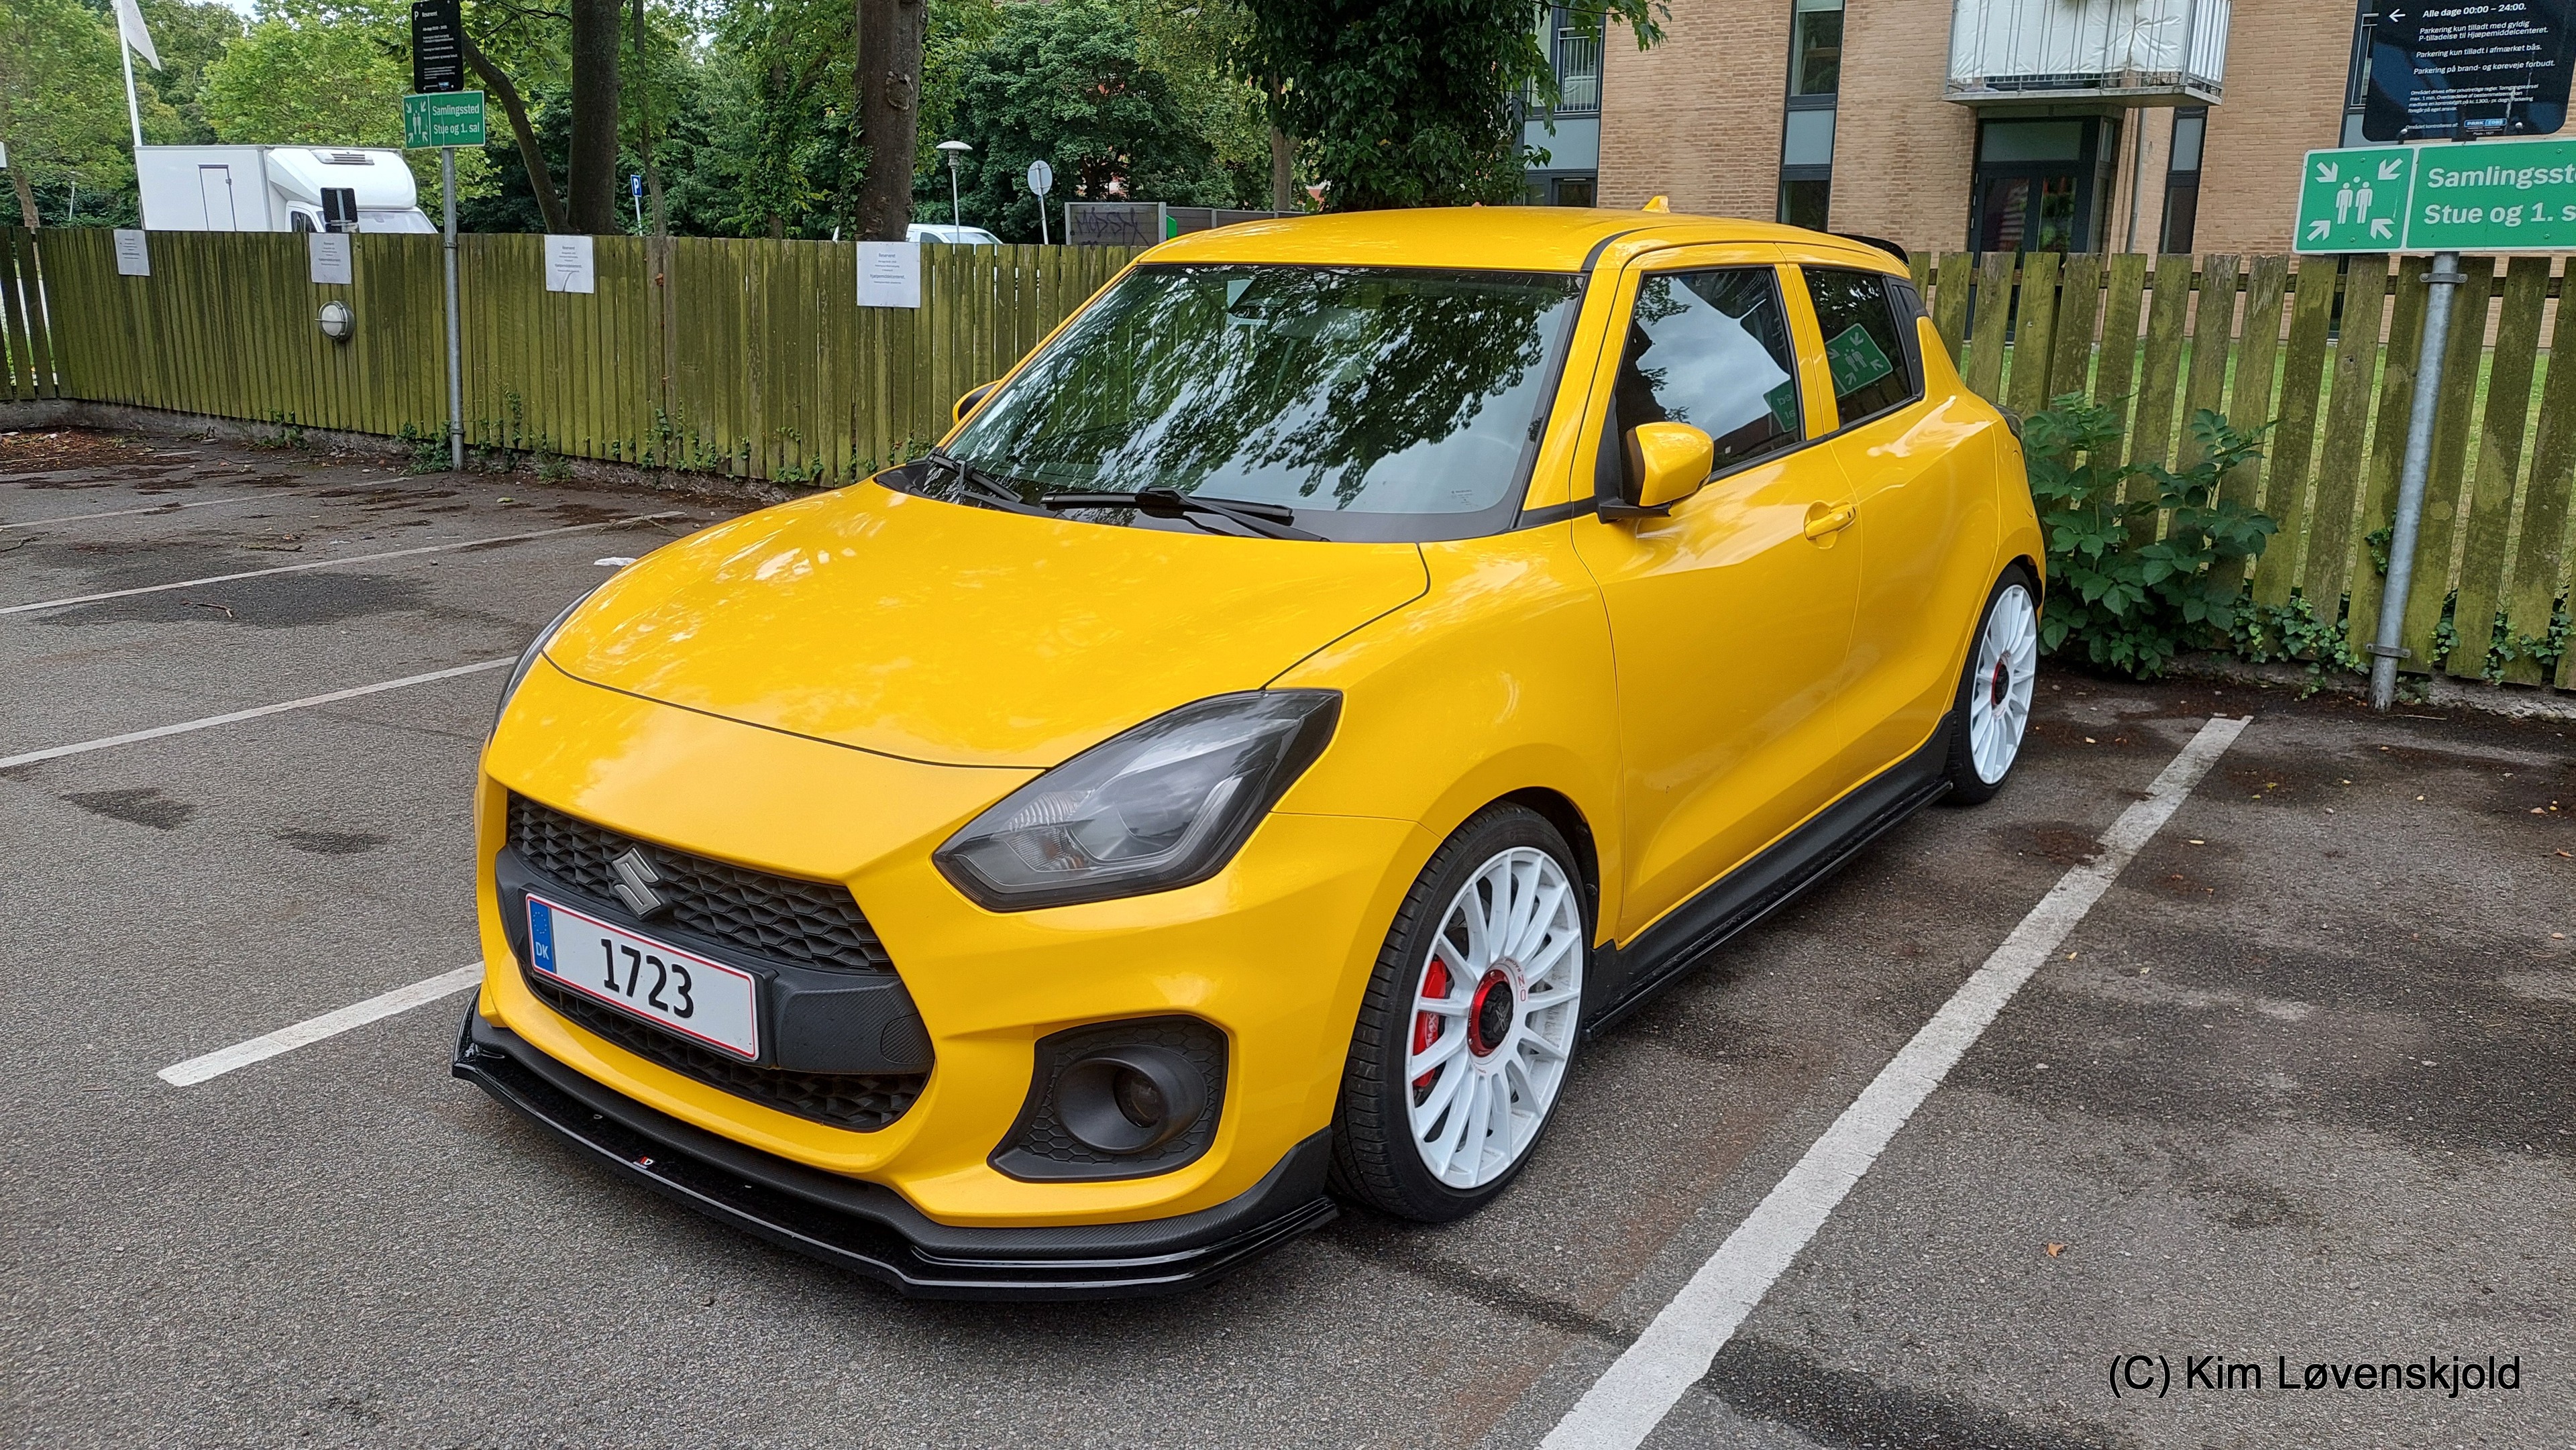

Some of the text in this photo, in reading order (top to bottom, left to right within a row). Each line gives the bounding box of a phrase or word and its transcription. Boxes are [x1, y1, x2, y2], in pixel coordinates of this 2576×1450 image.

[414, 11, 419, 21] P
[2440, 9, 2461, 17] dage
[2463, 6, 2489, 14] 00:00
[2498, 3, 2526, 11] 24:00.
[2420, 26, 2453, 34] Parkering
[2508, 21, 2530, 29] gyldig
[2489, 45, 2525, 53] afmærket
[2526, 43, 2542, 51] bås.
[2447, 65, 2456, 73] på
[2493, 62, 2524, 70] køreveje
[2526, 60, 2555, 68] forbudt.
[432, 103, 480, 117] Samlingssted
[433, 121, 480, 135] Stue og 1. sal
[633, 178, 639, 194] P
[2424, 204, 2483, 224] Stue
[2489, 205, 2524, 227] og
[2530, 202, 2554, 223] 1.
[535, 941, 549, 960] DK
[601, 938, 694, 1019] 1723
